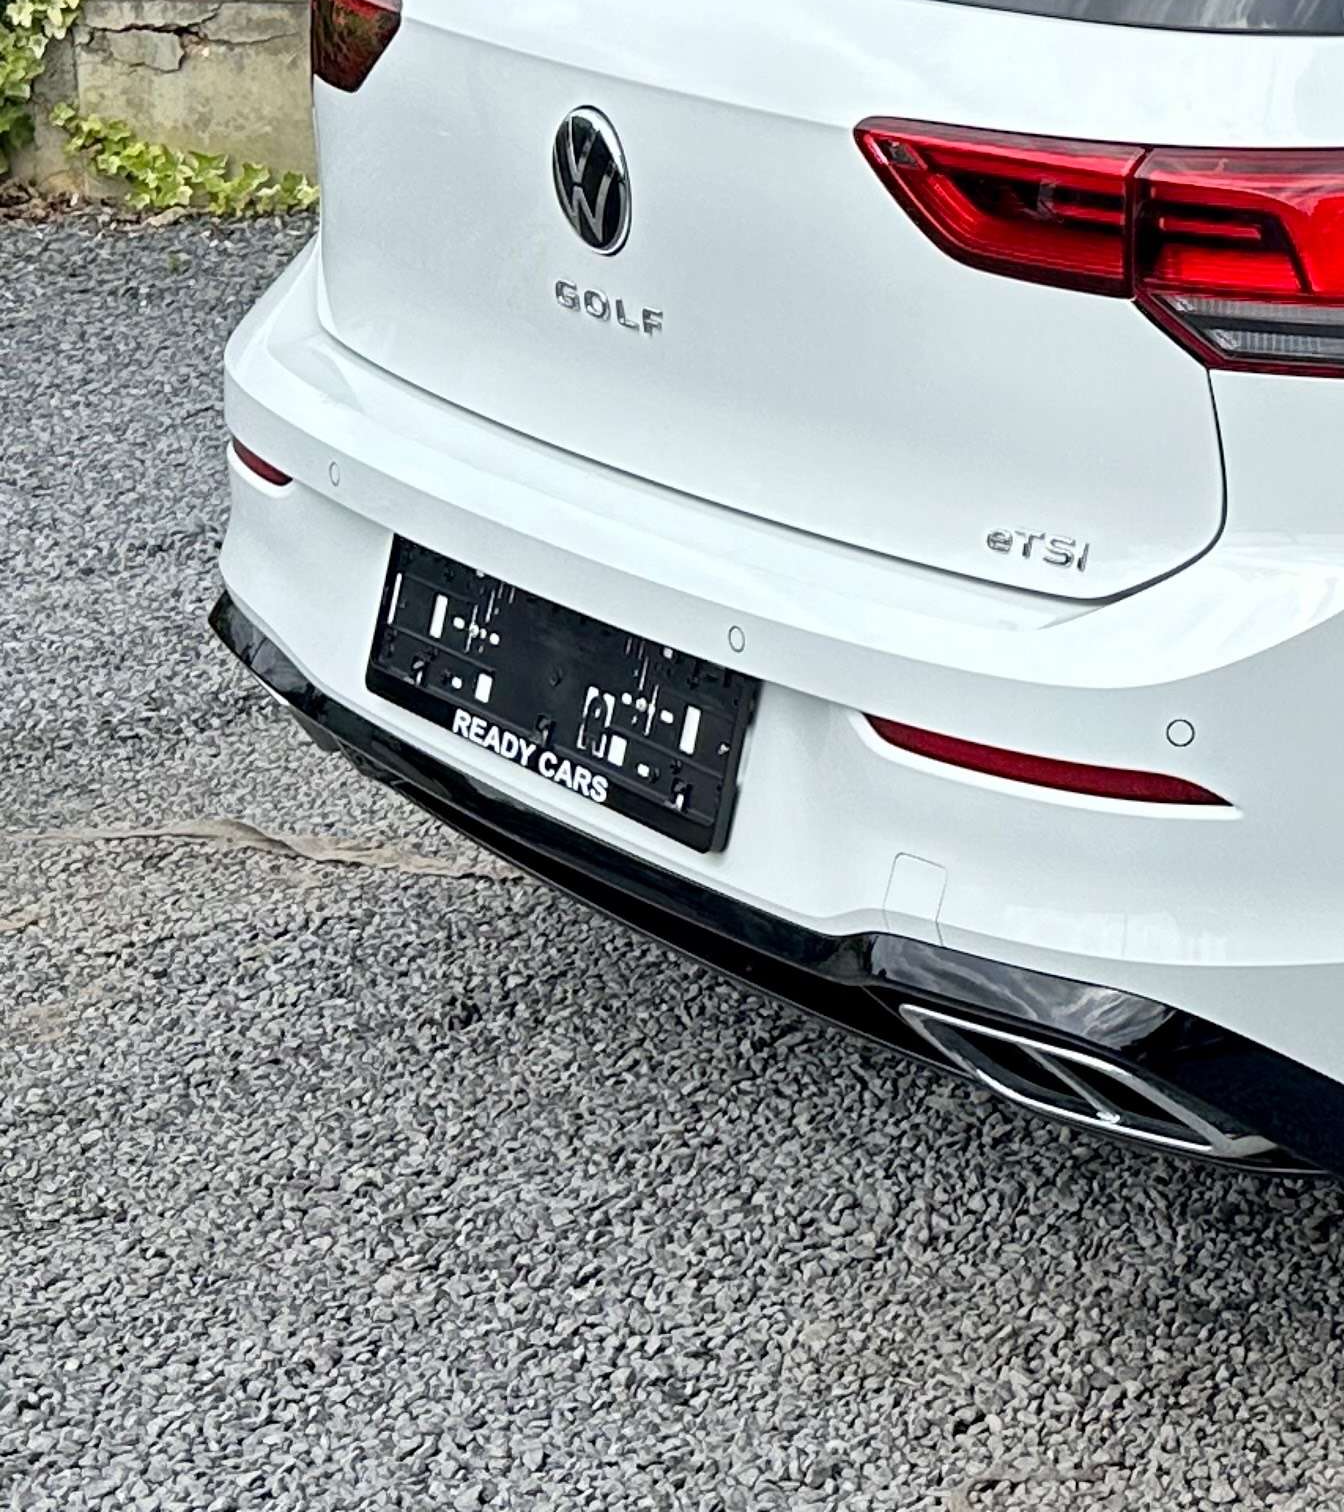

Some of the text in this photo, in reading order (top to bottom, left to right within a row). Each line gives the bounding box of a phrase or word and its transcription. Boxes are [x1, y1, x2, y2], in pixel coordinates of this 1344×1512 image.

[555, 279, 664, 338] GOLF
[986, 528, 1090, 573] eTSI
[452, 708, 609, 803] READY CARS
